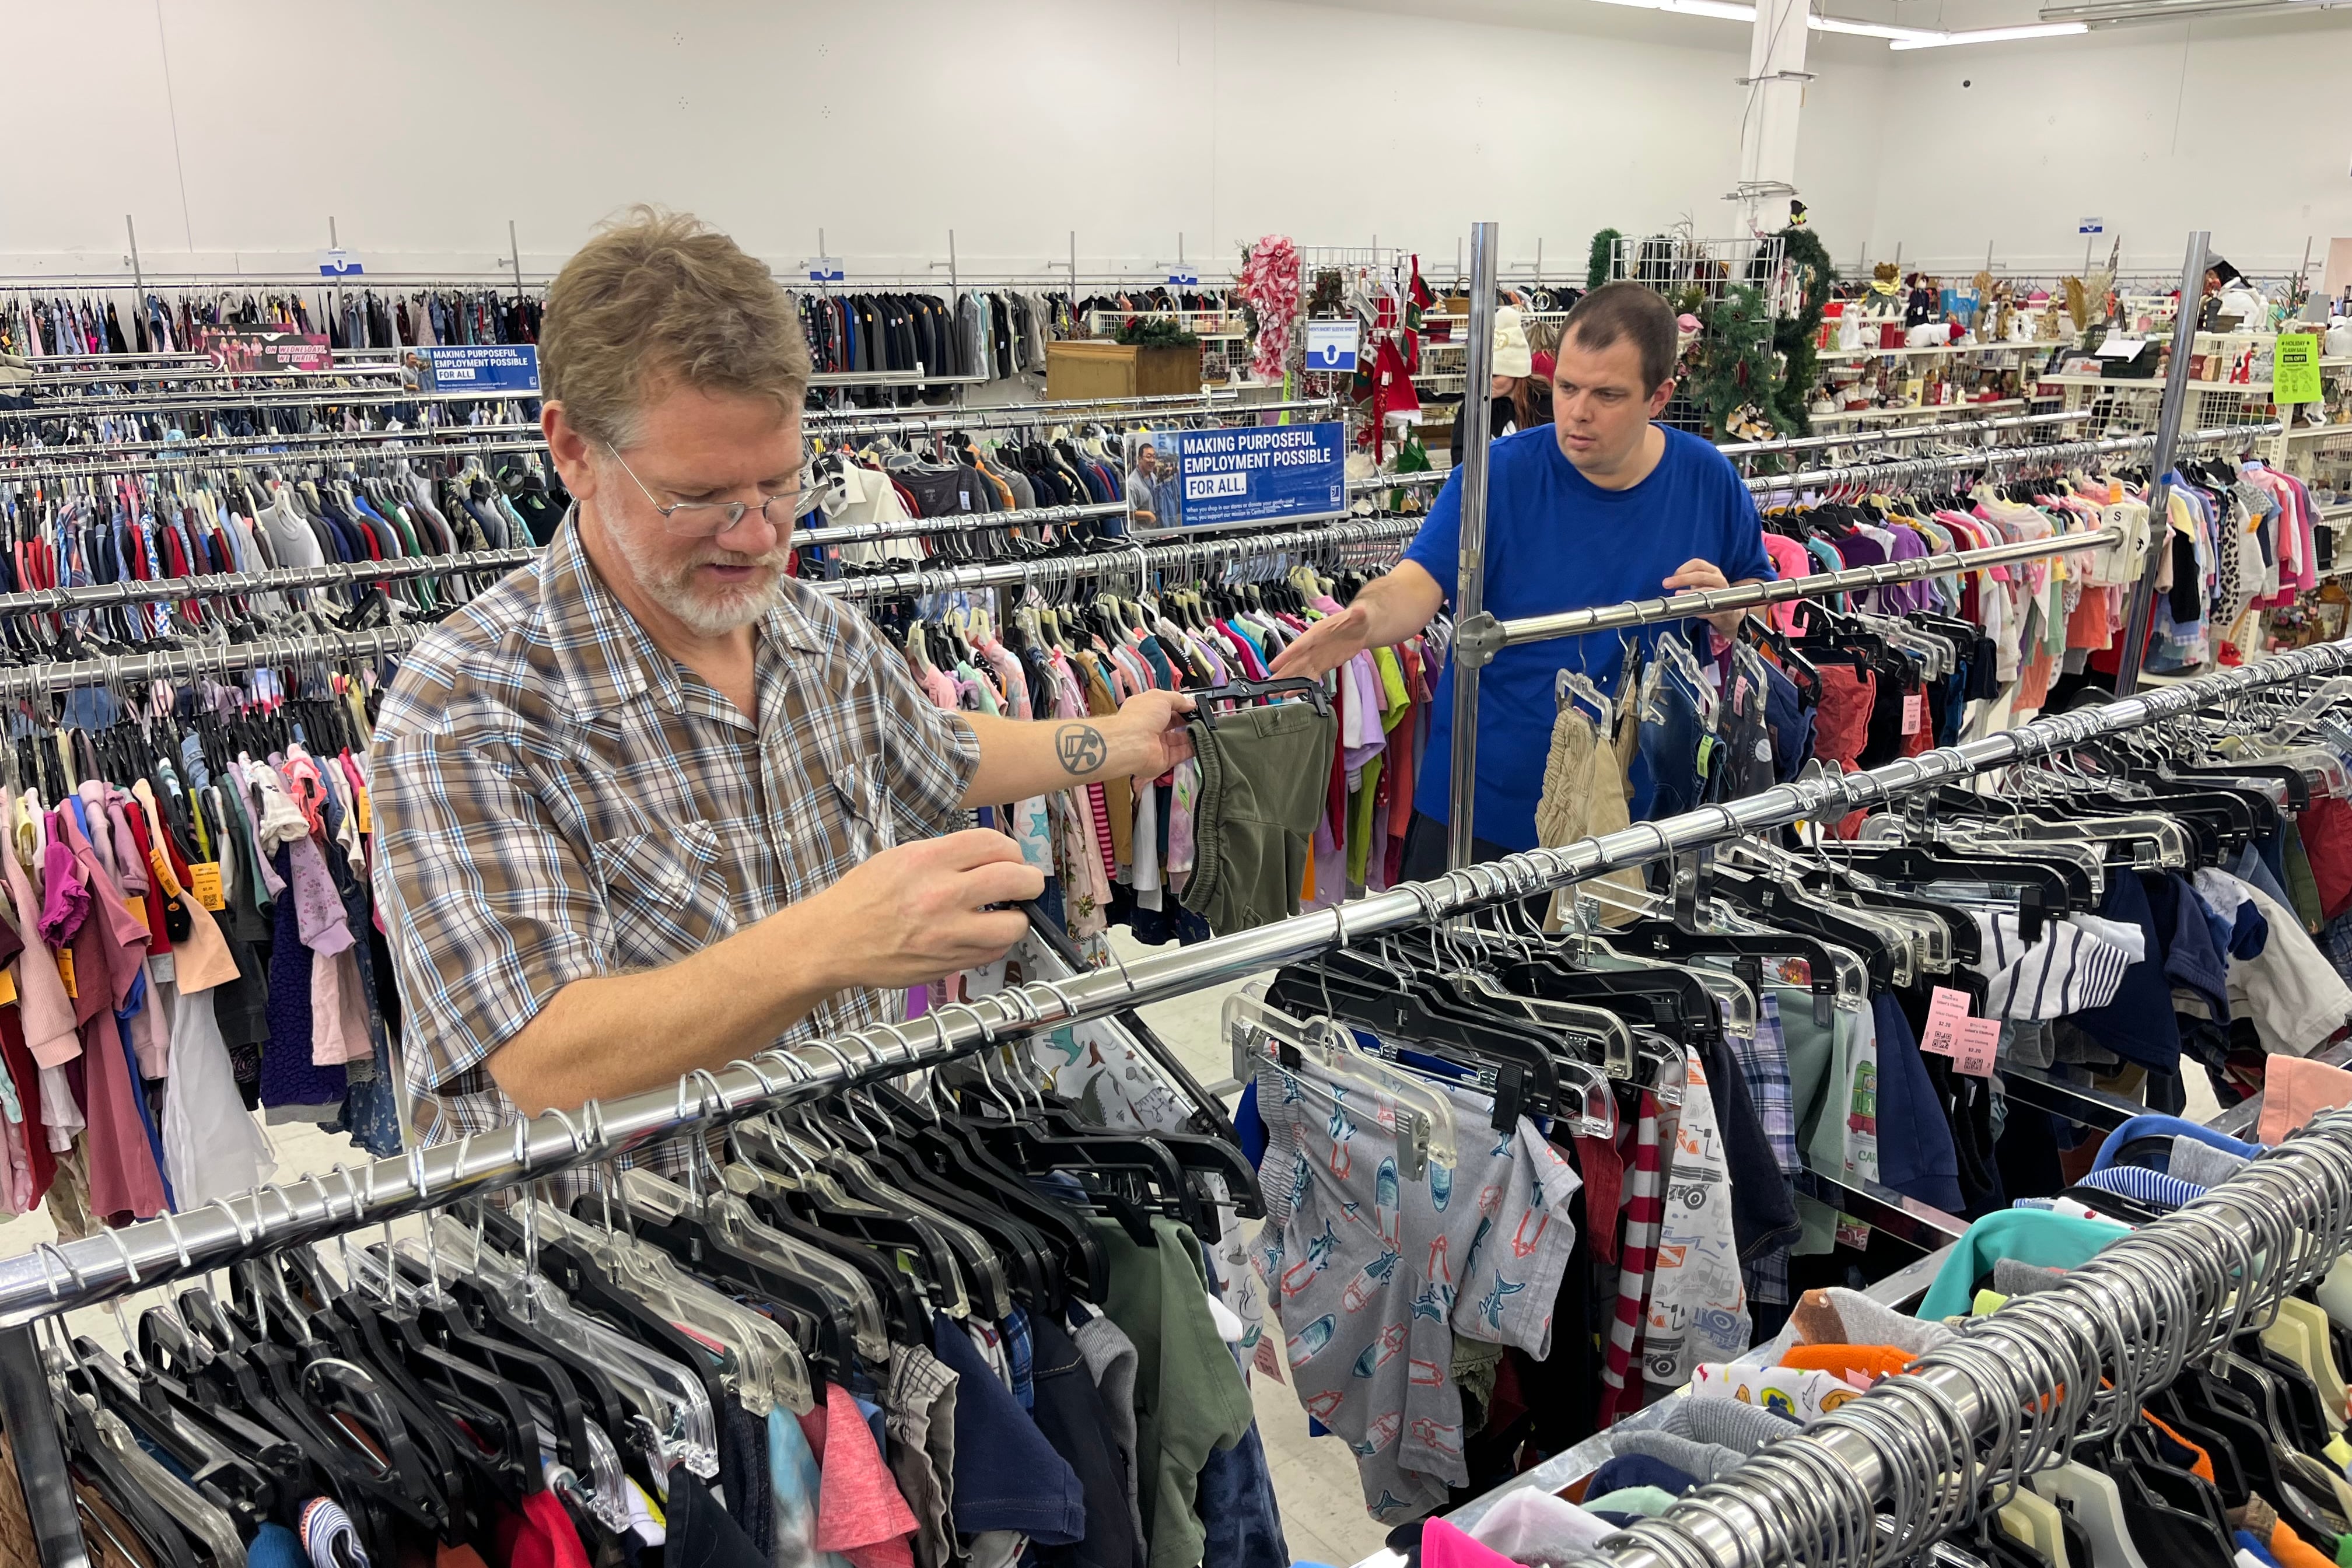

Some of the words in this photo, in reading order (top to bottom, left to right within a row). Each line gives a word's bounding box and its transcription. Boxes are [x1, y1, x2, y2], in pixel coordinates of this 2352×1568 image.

[265, 345, 277, 354] ON
[433, 351, 466, 359] MAKING
[467, 349, 518, 358] PURPOSEFUL
[278, 354, 290, 363] WE
[435, 359, 489, 368] EMPLOYMENT
[491, 358, 528, 366] POSSIBLE
[439, 370, 455, 379] FOR
[1184, 436, 1235, 454] MAKING
[1238, 430, 1317, 451] PURPOSEFUL
[1184, 452, 1270, 474] EMPLOYMENT
[1273, 447, 1331, 467] POSSIBLE
[1190, 480, 1214, 495] FOR
[1218, 478, 1244, 494] ALL.
[2113, 511, 2122, 522] S
